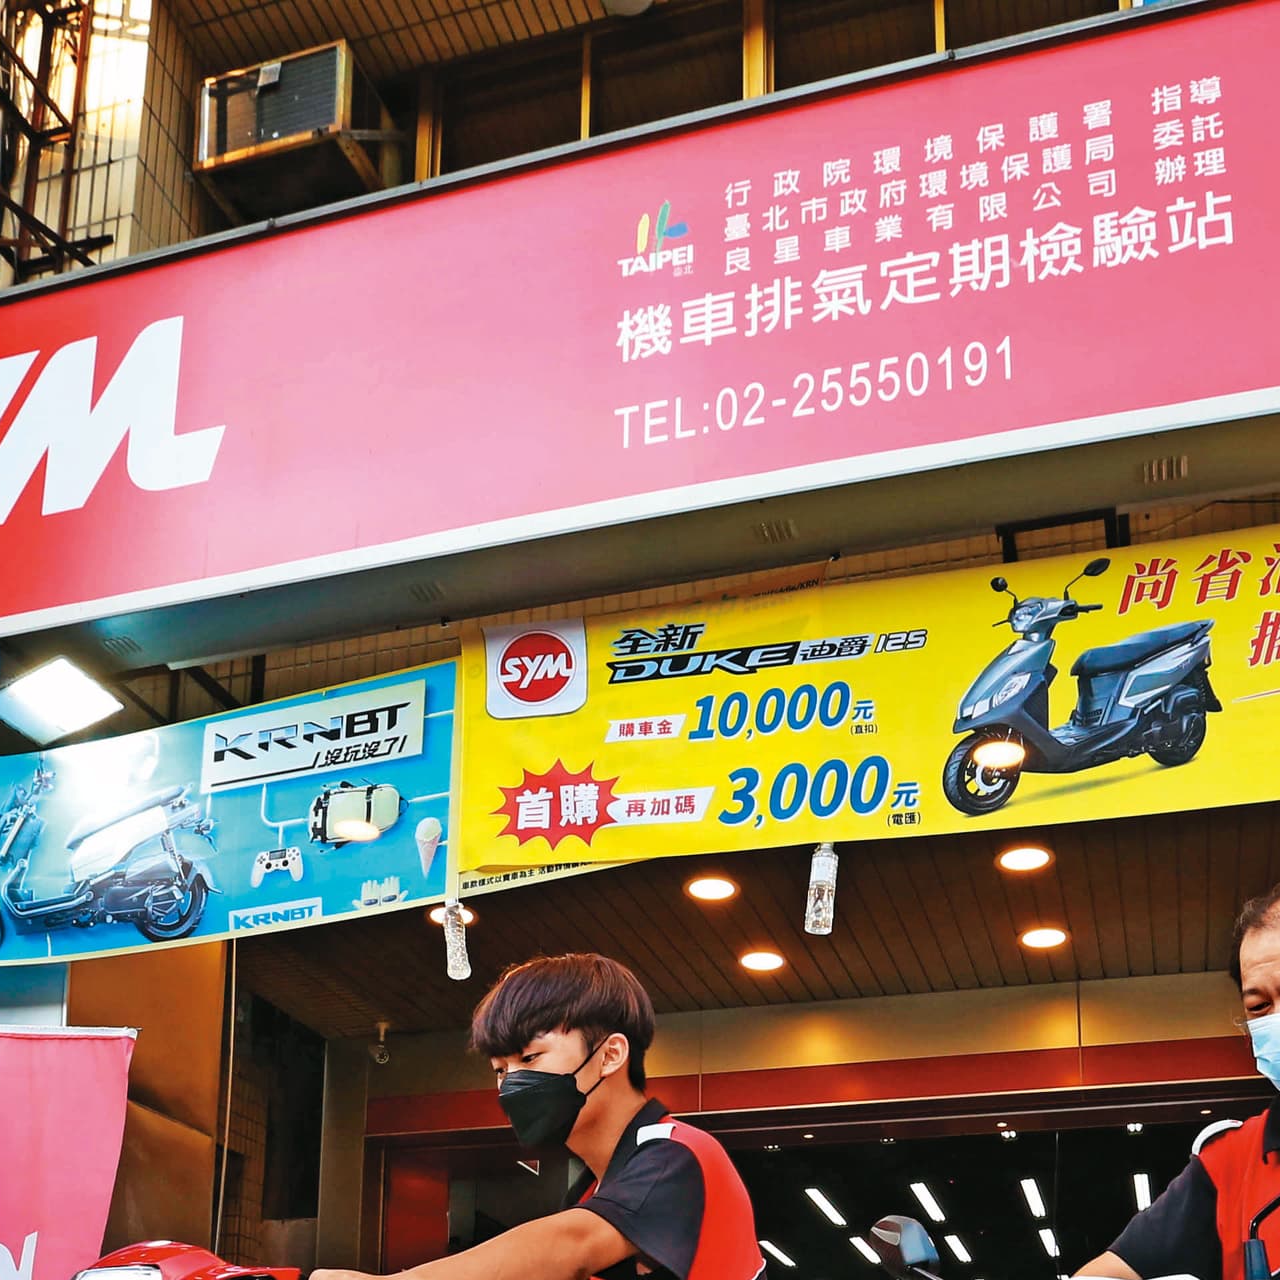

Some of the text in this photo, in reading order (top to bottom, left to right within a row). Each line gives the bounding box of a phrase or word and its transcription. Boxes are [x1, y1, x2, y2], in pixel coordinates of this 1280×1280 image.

[724, 75, 1223, 208] 行政院環境保護署 指導
[723, 114, 1225, 243] 臺北市政府環境保護局 委託
[724, 147, 1227, 277] 良星車業有限公司 辦理
[615, 190, 1235, 364] 機車排氣定期檢驗站
[617, 243, 694, 278] TAIPEI
[613, 335, 1016, 449] TEL:02-25550191
[610, 642, 799, 684] DUKE
[874, 629, 928, 654] 125
[612, 623, 706, 657] 全新
[497, 650, 575, 690] SYM
[214, 702, 411, 762] KRNBT
[619, 719, 673, 738] 購車金
[516, 783, 600, 829] 首購
[625, 792, 696, 818] 再加碼
[233, 905, 318, 930] KRNBT
